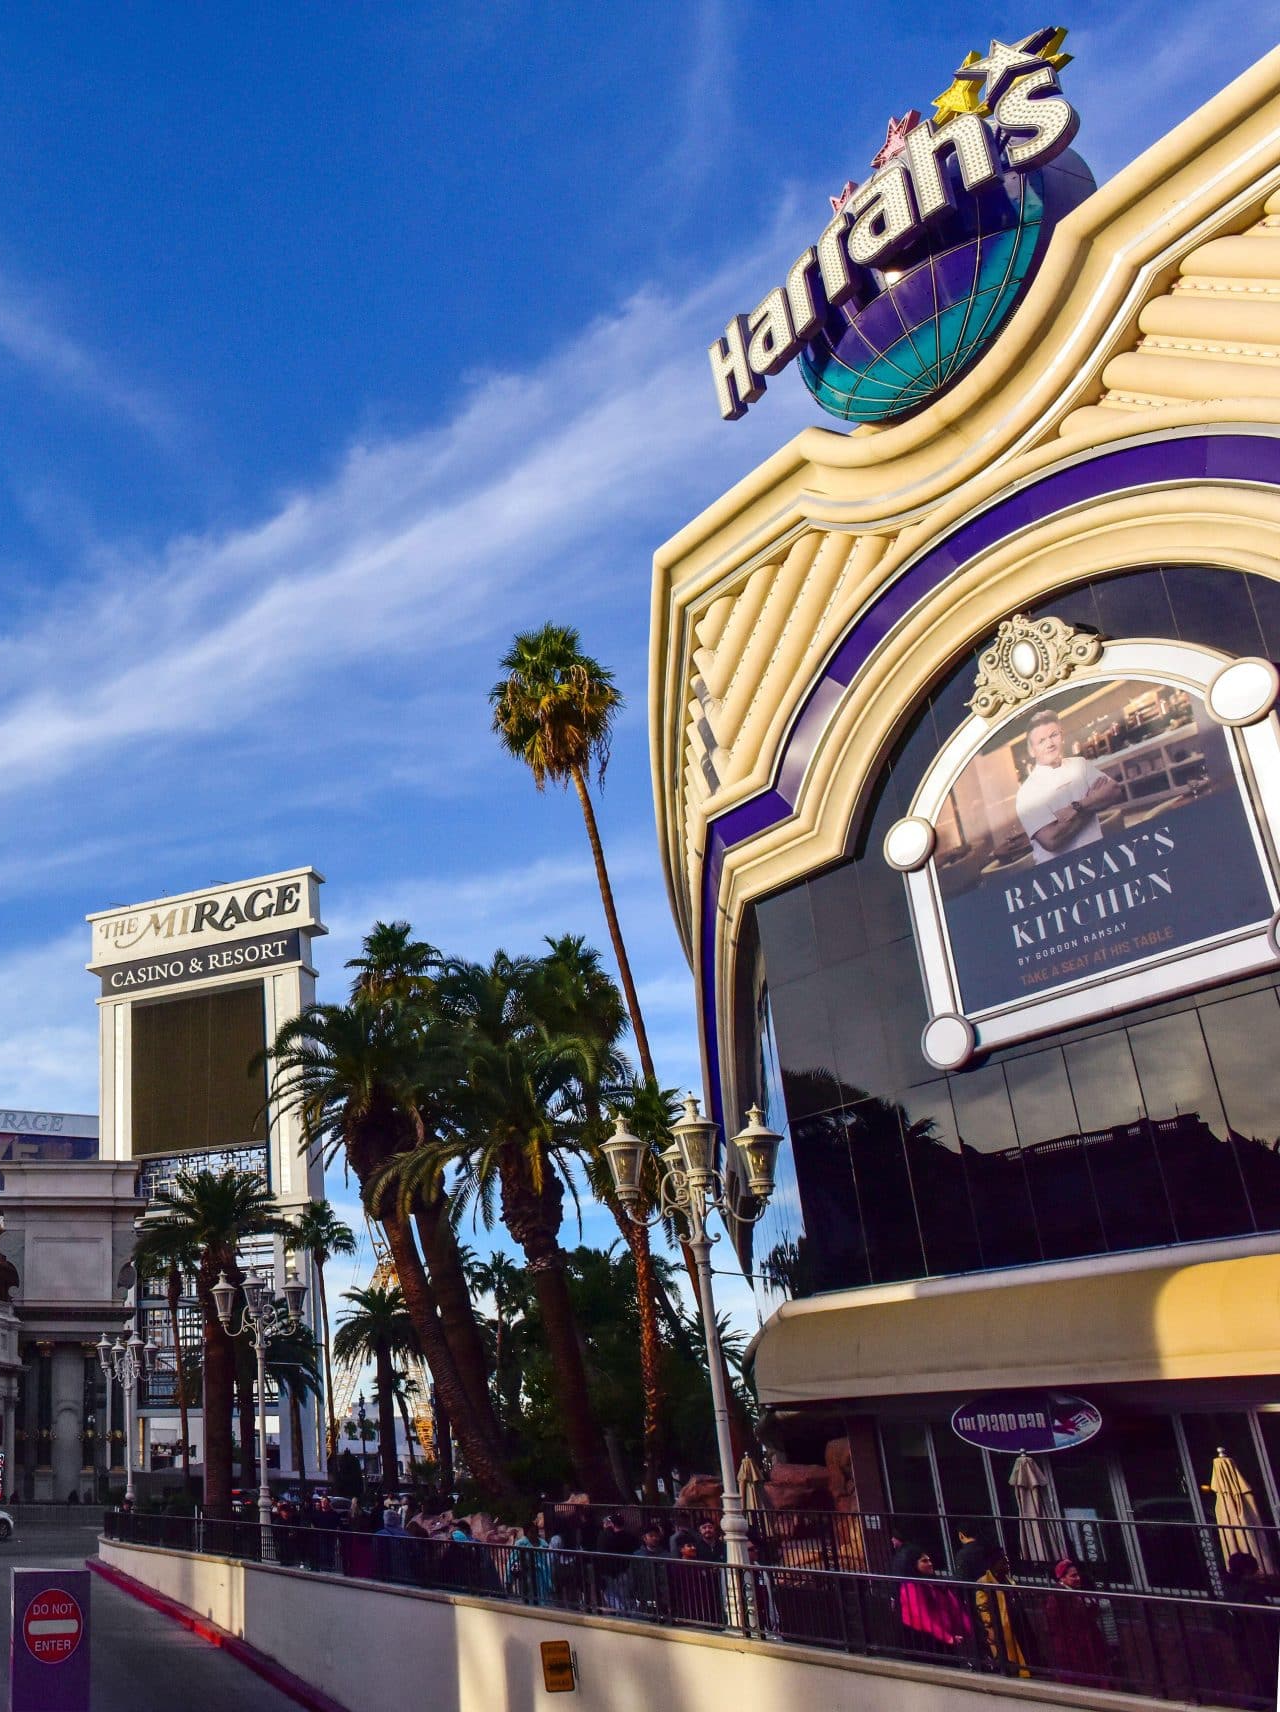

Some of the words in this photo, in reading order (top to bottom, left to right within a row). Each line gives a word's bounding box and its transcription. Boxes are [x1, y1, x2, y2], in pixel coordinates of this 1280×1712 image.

[1004, 827, 1175, 914] RAMSAY'S
[99, 917, 139, 940] THE
[115, 882, 300, 949] MIRAGE
[1011, 868, 1173, 949] KITCHEN
[111, 960, 184, 988] CASINO
[189, 957, 203, 974] &
[208, 940, 288, 970] RESORT
[1018, 956, 1030, 967] BY
[1036, 941, 1078, 961] GORDON
[1083, 922, 1128, 944] RAMSAY
[1021, 970, 1049, 986] TAKE
[1052, 964, 1060, 977] A
[1061, 954, 1089, 973] SEAT
[1093, 949, 1107, 964] AT
[1111, 941, 1131, 957] HIS
[1134, 926, 1175, 949] TABLE
[958, 1417, 976, 1431] THE
[32, 1604, 49, 1615] DO
[52, 1602, 74, 1615] NOT
[35, 1639, 71, 1652] ENTER
